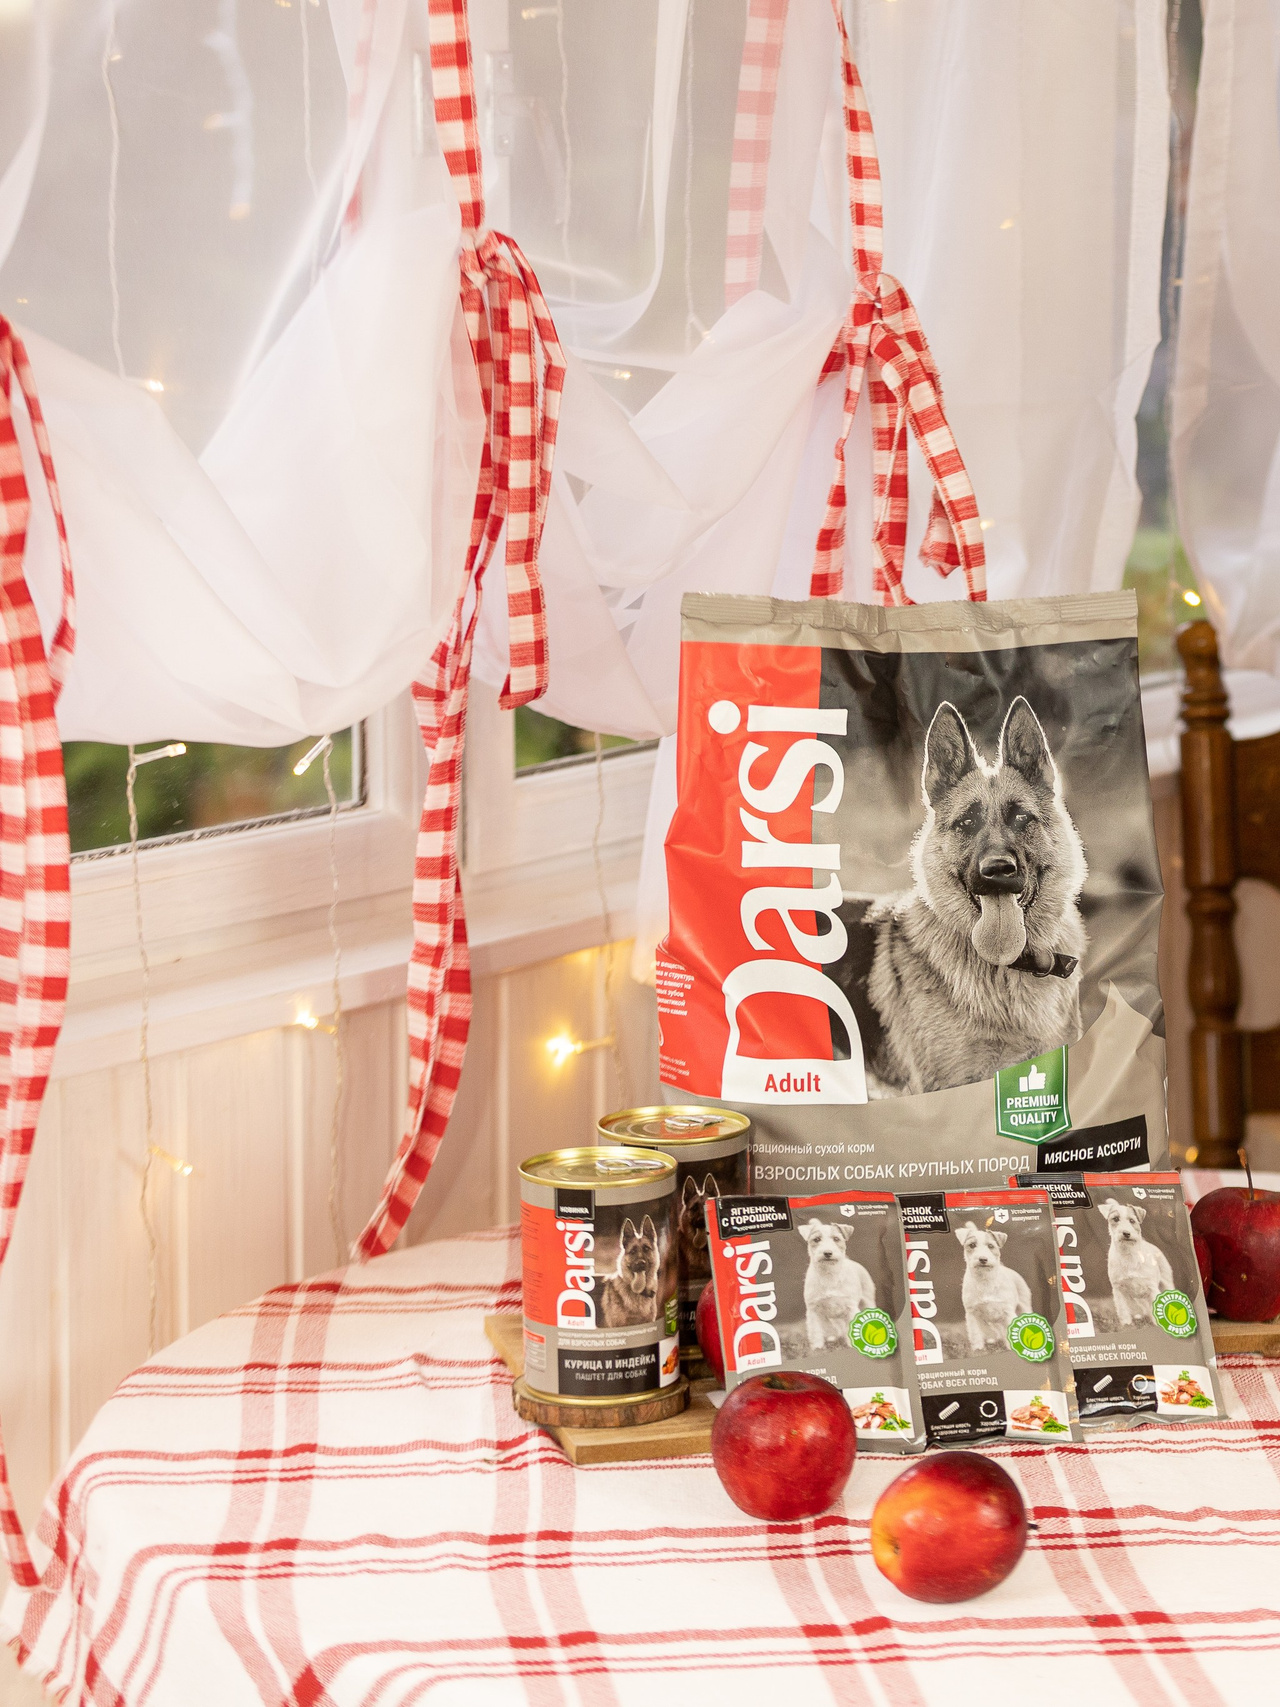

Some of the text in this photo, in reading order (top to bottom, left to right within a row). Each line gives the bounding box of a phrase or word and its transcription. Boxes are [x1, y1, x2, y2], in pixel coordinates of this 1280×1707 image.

[708, 700, 868, 1104] Darsi
[765, 1072, 822, 1093] Adult
[1007, 1094, 1059, 1109] PREMIUM
[1010, 1111, 1058, 1126] QUALITY
[748, 1142, 875, 1157] орационный сухой корм
[1044, 1136, 1142, 1165] МЯСНОЕ АССОРТИ
[754, 1155, 1030, 1181] ВЗРОСЛЫХ СОБАК КРУПНЫХ ПОРОД
[1051, 1191, 1086, 1199] ОШКОМ
[731, 1205, 776, 1216] ЯГНЕНОК
[901, 1206, 933, 1215] НЕНОК
[730, 1213, 788, 1226] ГОРОШКОМ
[901, 1215, 944, 1223] РОШКОМ
[556, 1220, 597, 1329] Darsi
[723, 1240, 782, 1374] Darsi
[1069, 1343, 1137, 1354] орационный корм
[564, 1353, 656, 1371] КУРИЦА И ИНДЕЙКА
[1070, 1351, 1148, 1363] СОБАК ВСЕХ ПОРОД
[575, 1368, 648, 1381] ПАШТЕТ ДЛЯ СОБАК
[967, 1368, 988, 1377] корм
[946, 1378, 967, 1387] ВСЕХ
[969, 1376, 998, 1387] ПОРОД
